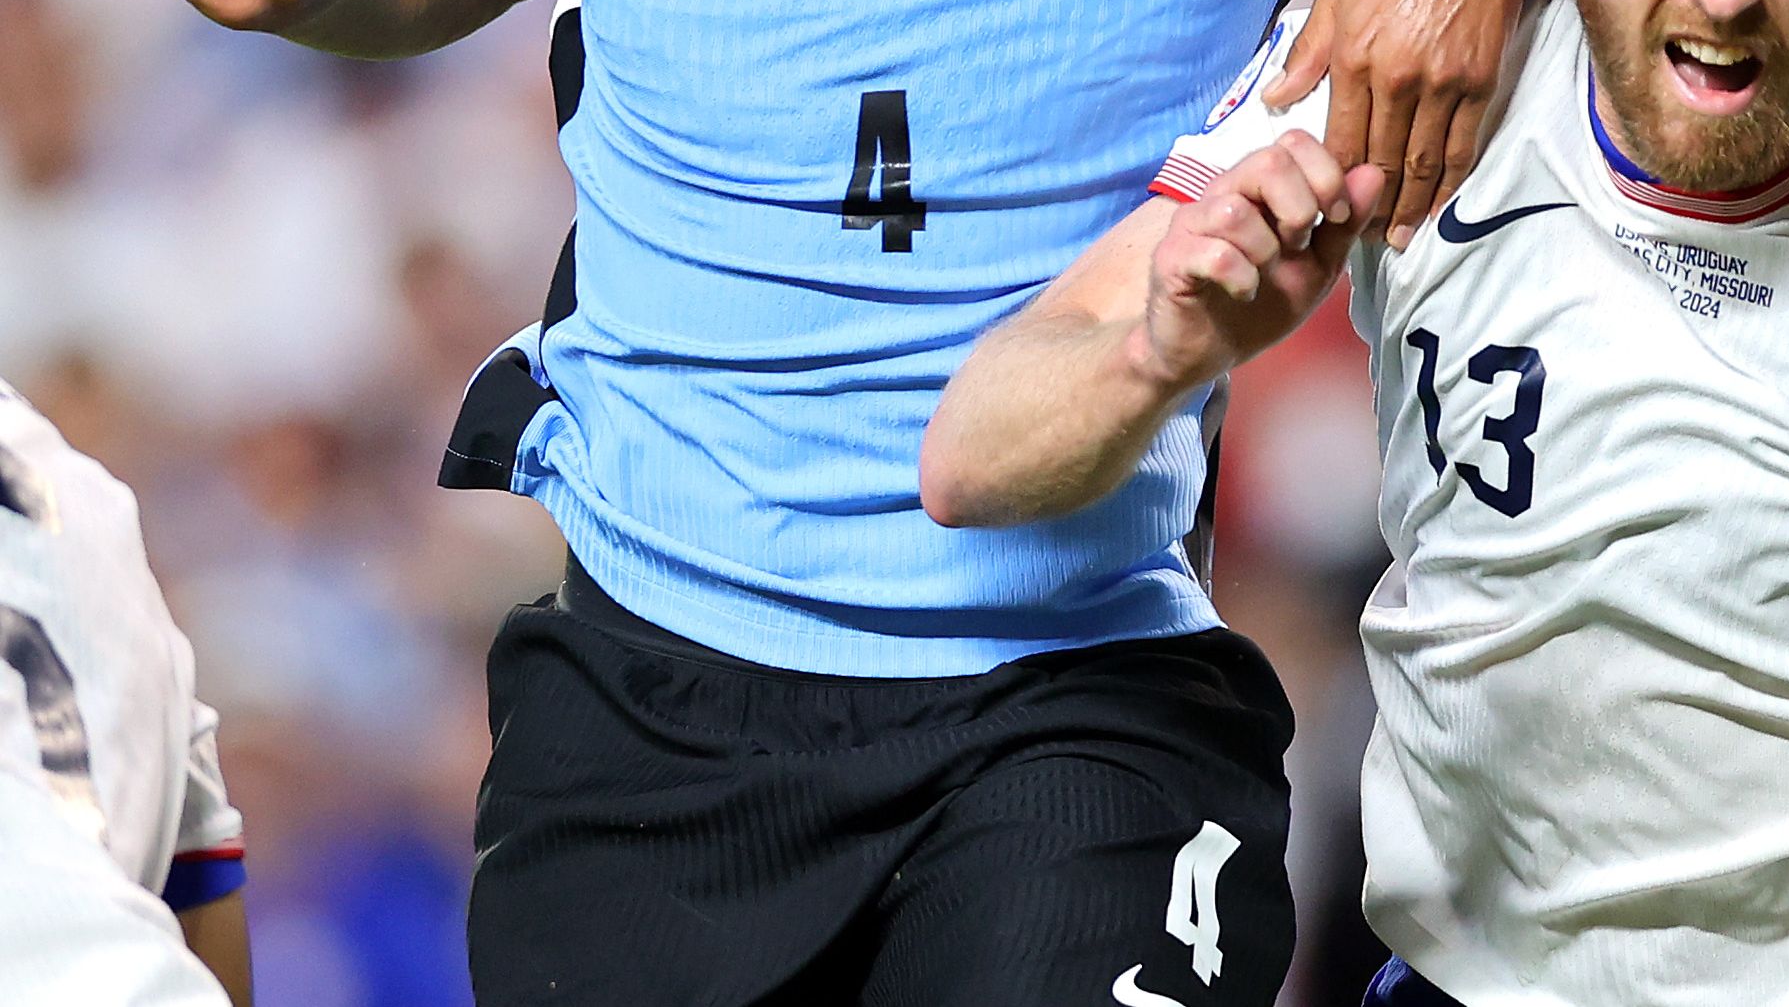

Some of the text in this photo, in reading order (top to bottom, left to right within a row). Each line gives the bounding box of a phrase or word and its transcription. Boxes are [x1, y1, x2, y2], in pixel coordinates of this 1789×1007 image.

[841, 90, 927, 253] 4
[1676, 243, 1748, 276] URUGUAY
[1680, 289, 1721, 319] 2024
[1700, 271, 1774, 308] MISSOURI
[1406, 327, 1547, 519] 13
[1165, 820, 1242, 987] 4
